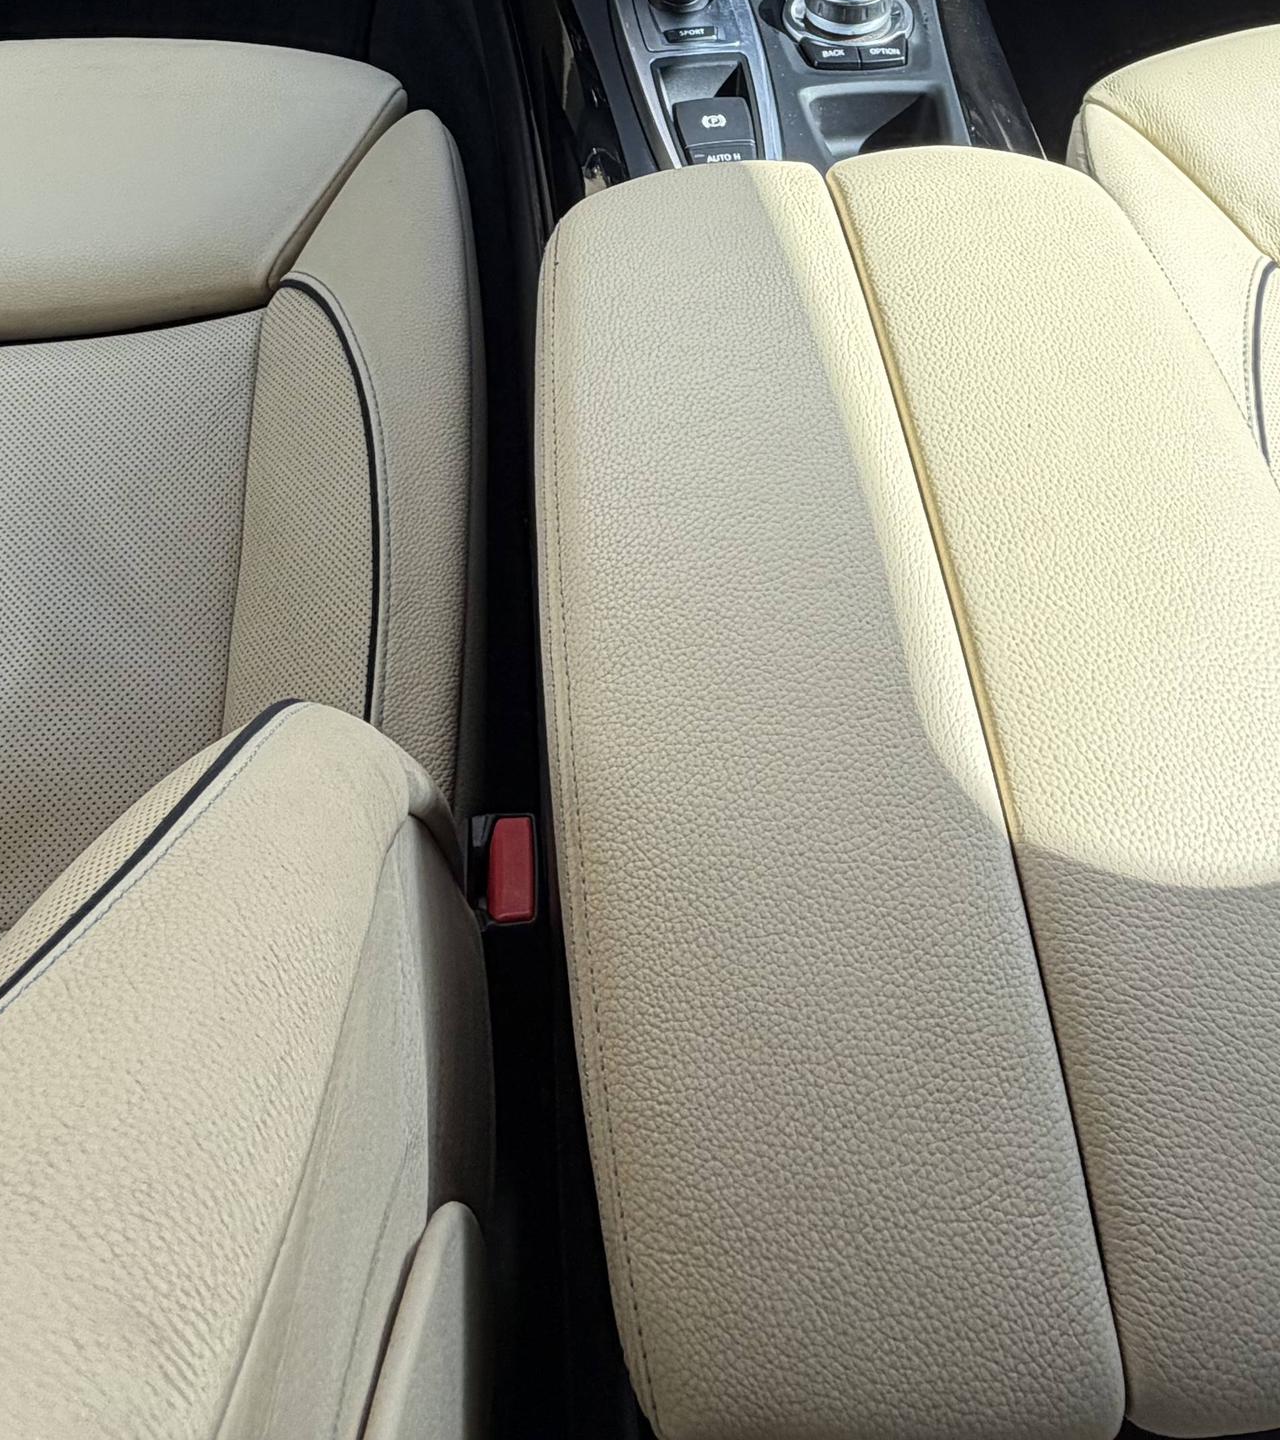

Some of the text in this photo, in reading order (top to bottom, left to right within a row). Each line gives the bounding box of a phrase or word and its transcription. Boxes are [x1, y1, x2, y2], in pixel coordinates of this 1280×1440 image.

[679, 27, 705, 37] SPORT
[822, 49, 845, 58] BACK
[869, 47, 901, 56] OPTION
[706, 153, 732, 163] AUTO
